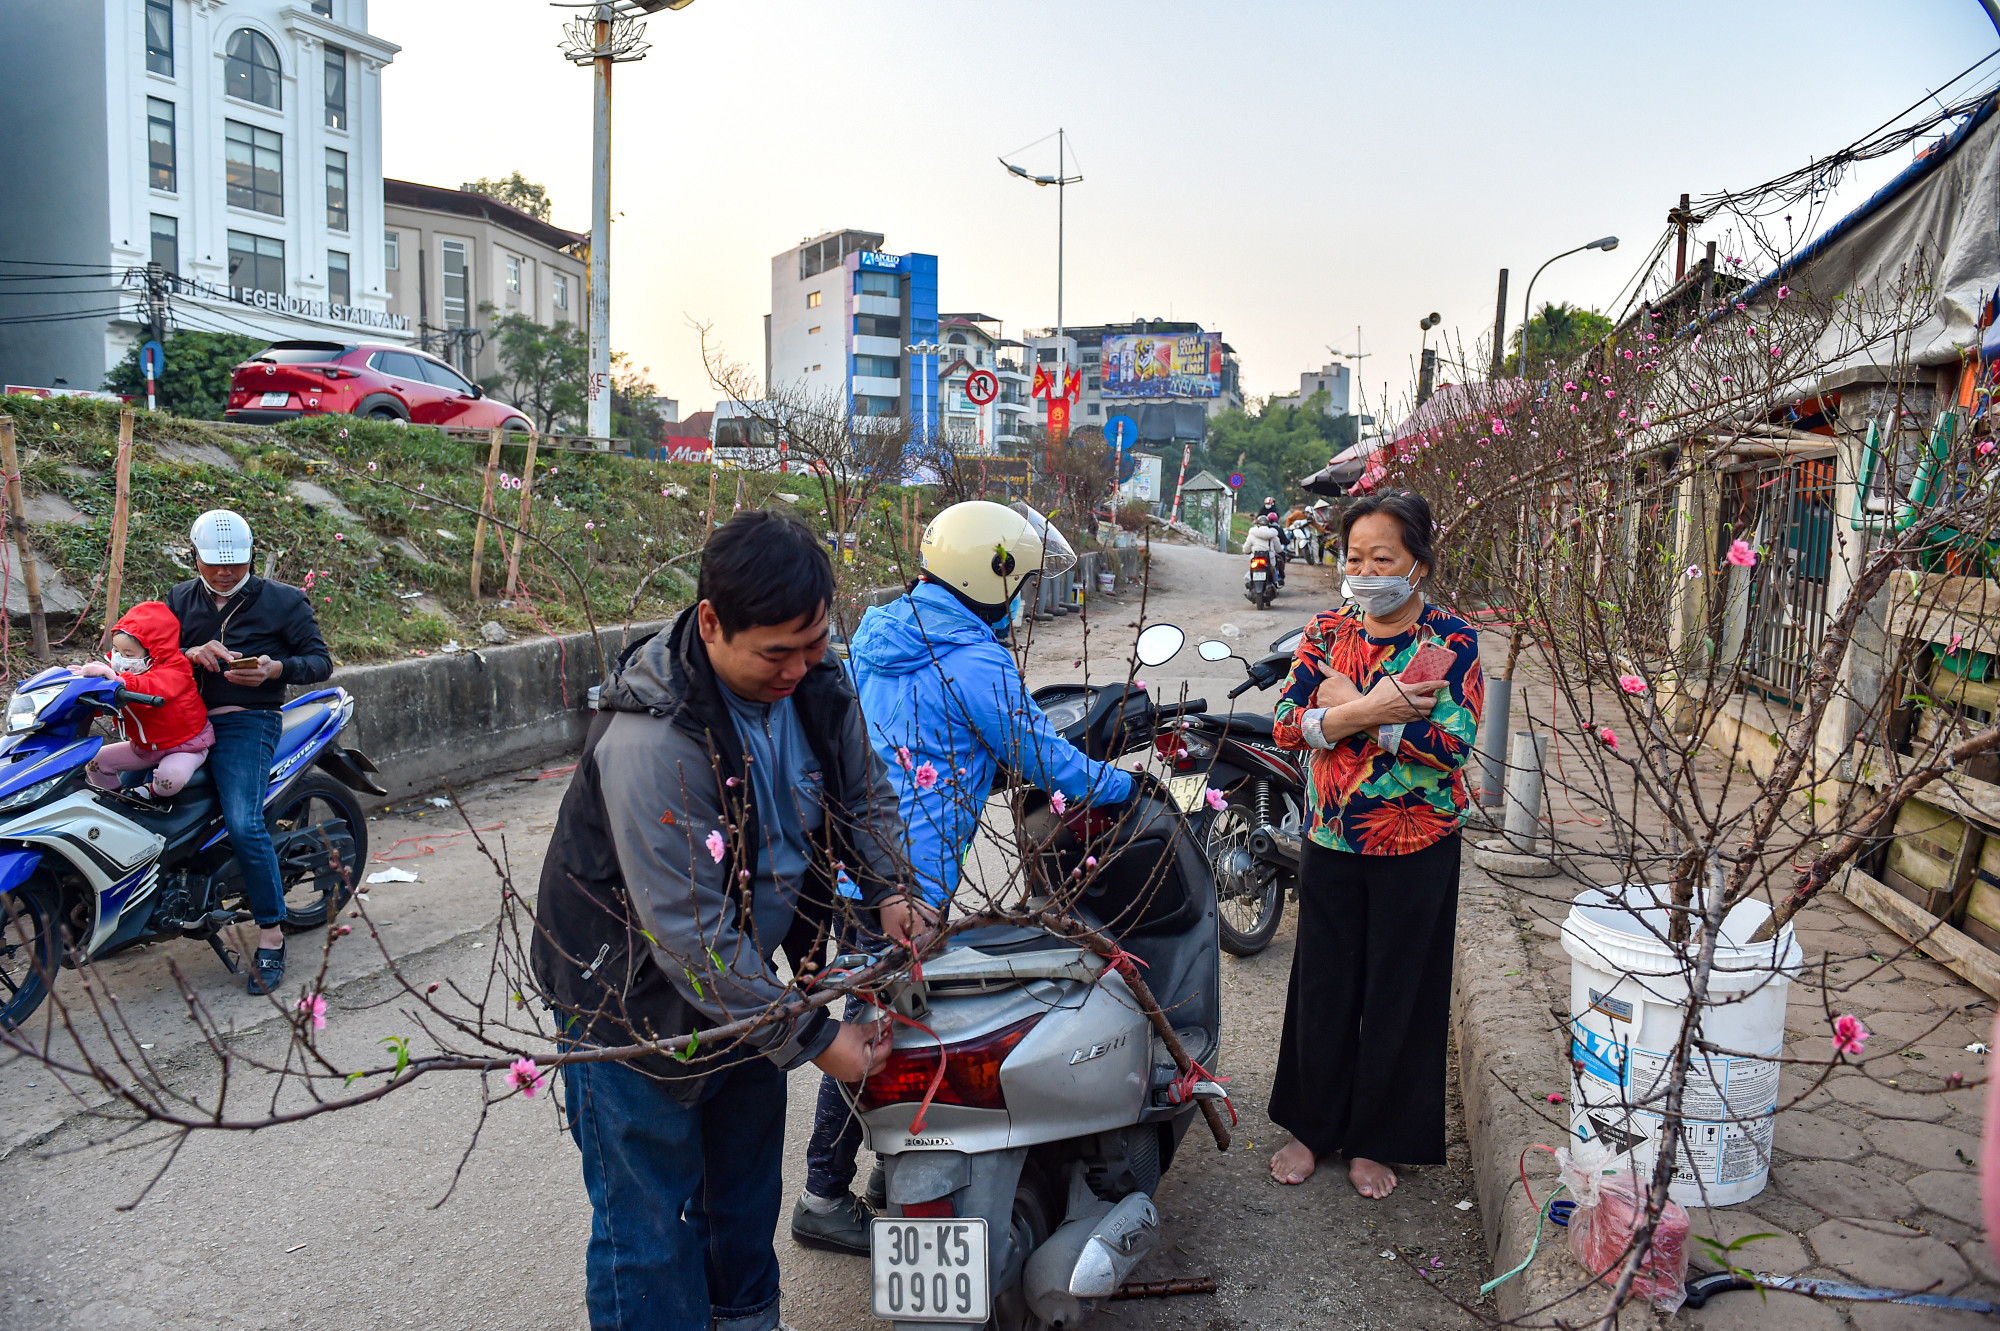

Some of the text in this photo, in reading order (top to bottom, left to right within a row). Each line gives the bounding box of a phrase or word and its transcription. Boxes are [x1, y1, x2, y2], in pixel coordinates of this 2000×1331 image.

[308, 299, 411, 331] RESTAURANT
[904, 1136, 954, 1147] HONDA
[888, 1225, 970, 1267] 30-K5
[888, 1271, 971, 1314] 0909
